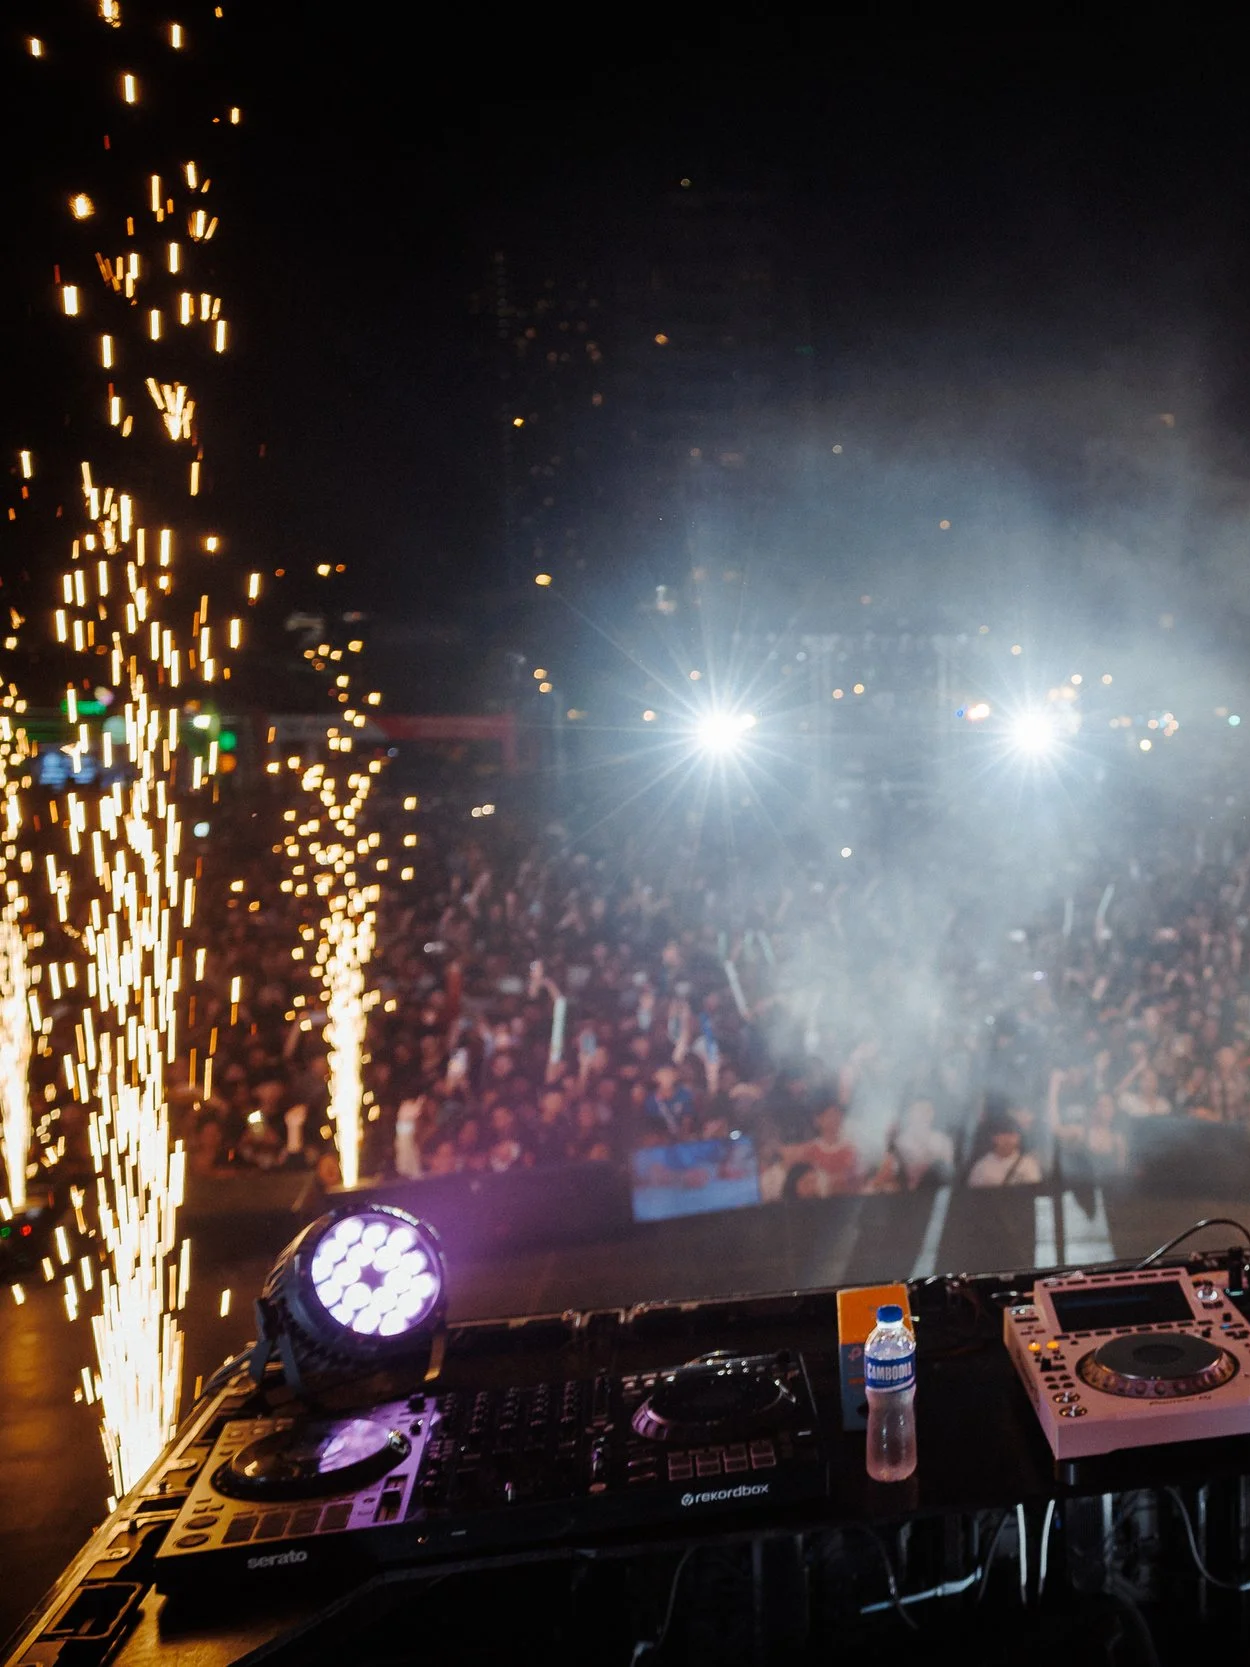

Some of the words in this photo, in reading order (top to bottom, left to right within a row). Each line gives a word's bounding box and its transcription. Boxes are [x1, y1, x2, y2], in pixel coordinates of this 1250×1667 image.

[867, 1361, 912, 1381] CAMBODIA
[695, 1484, 769, 1503] rekordbox
[247, 1550, 308, 1569] serato
